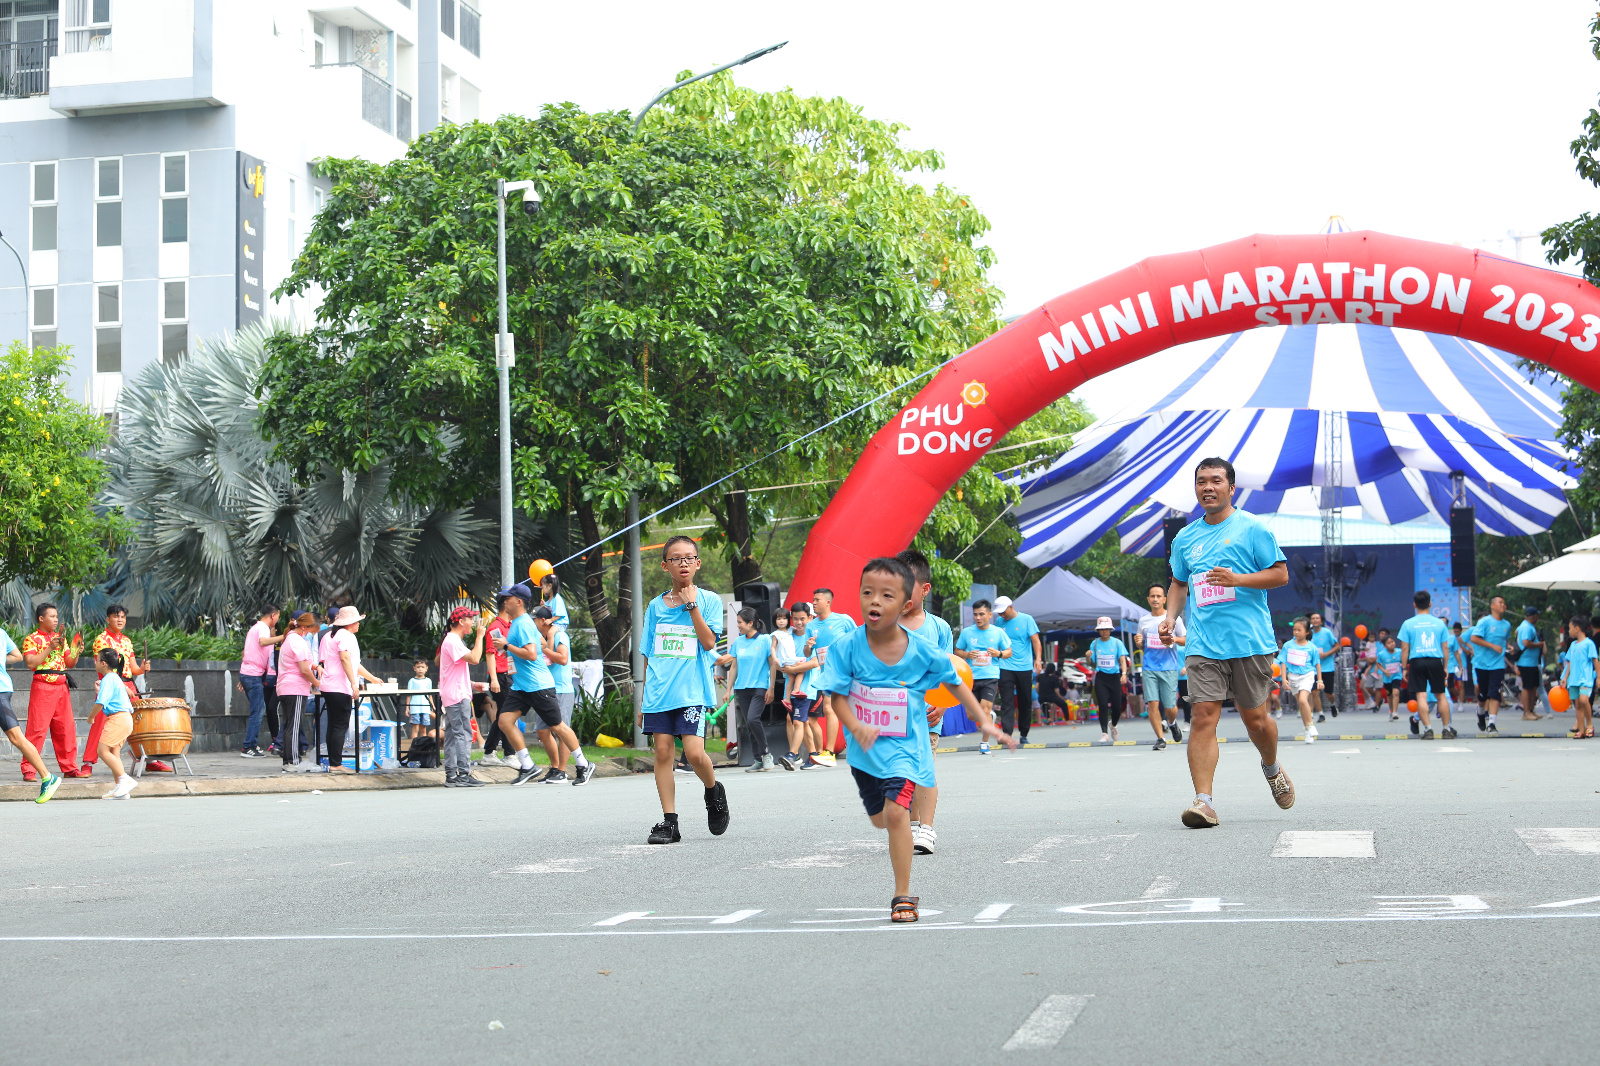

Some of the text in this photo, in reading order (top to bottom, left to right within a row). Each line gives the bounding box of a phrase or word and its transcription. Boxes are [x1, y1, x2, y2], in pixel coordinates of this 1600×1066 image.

[1037, 262, 1600, 372] MINI MARATHON 2023
[1254, 301, 1402, 328] START
[900, 402, 964, 429] PHU
[898, 427, 993, 455] DONG
[1201, 585, 1225, 598] 0510
[662, 639, 684, 651] 0371
[856, 704, 891, 726] 0510
